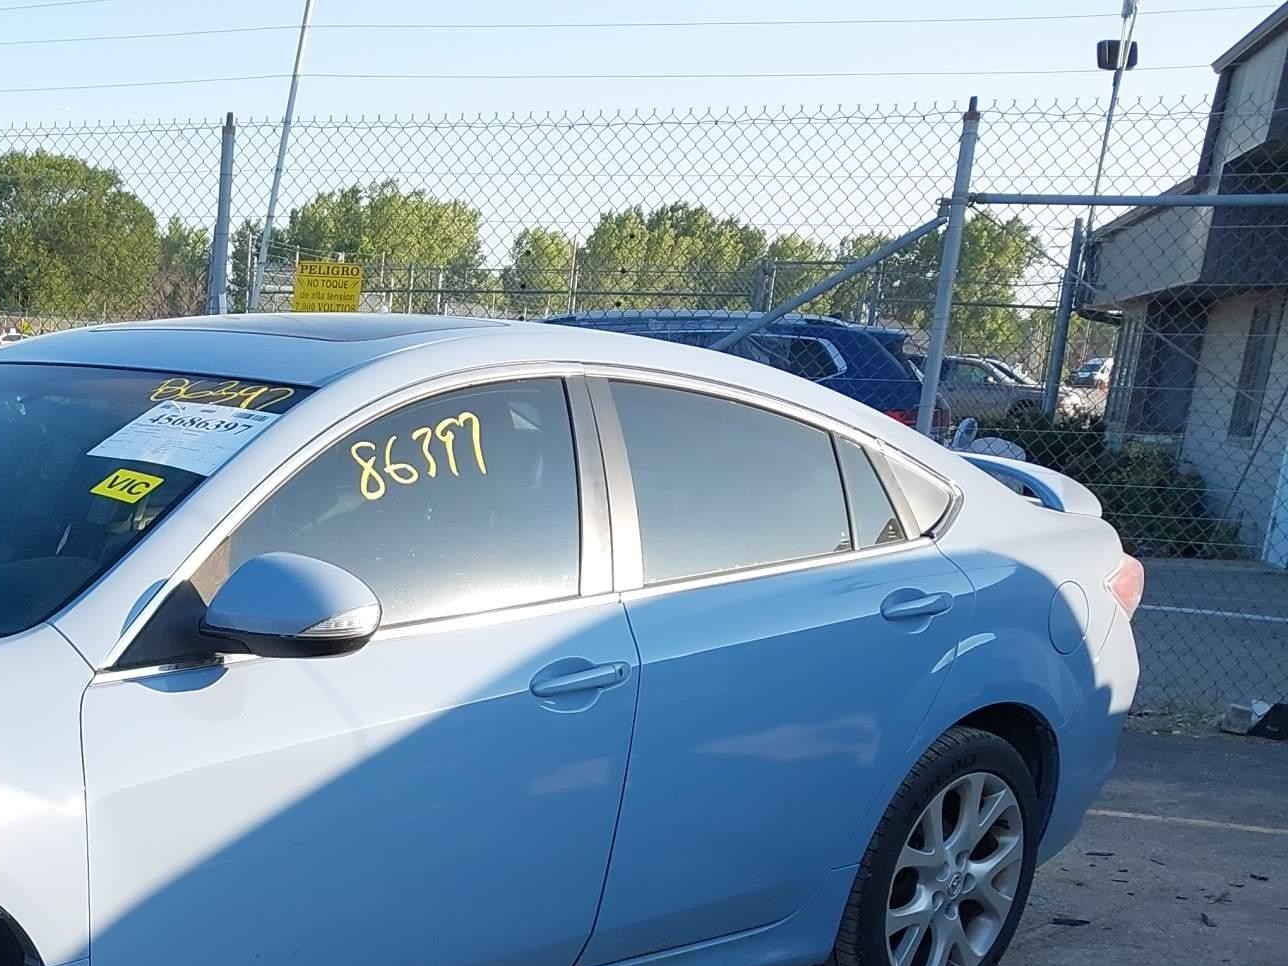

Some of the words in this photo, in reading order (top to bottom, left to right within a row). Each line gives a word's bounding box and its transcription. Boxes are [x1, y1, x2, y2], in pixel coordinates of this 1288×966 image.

[299, 265, 360, 276] PELIGRO
[307, 278, 319, 288] NO
[321, 279, 349, 289] TOQUE
[148, 413, 253, 435] 45686397
[351, 411, 487, 500] 86397
